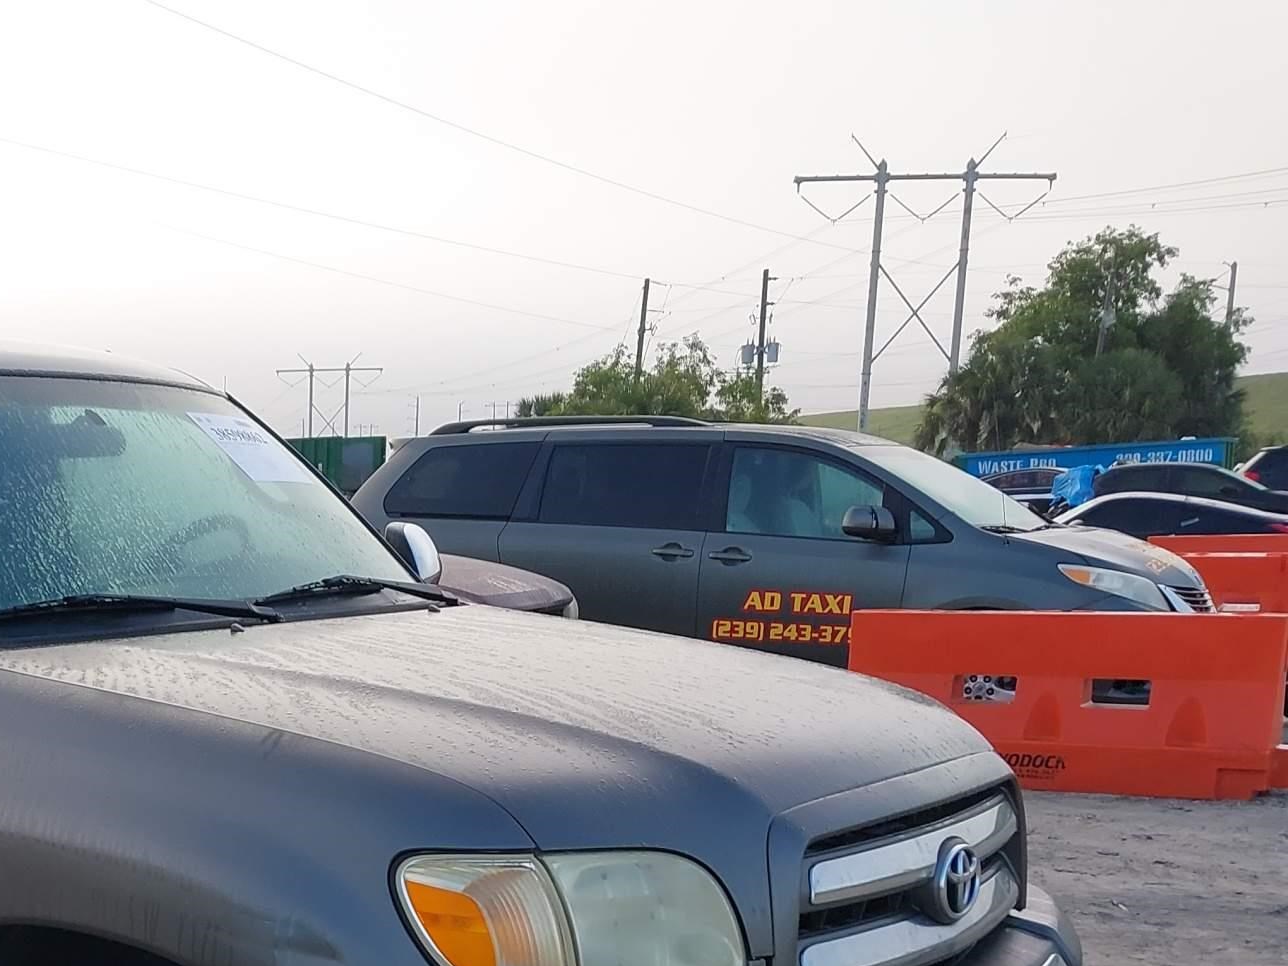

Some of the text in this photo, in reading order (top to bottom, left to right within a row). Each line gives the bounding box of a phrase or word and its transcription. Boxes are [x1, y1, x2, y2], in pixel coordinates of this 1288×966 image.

[978, 460, 1023, 474] WASTE
[743, 591, 852, 614] AD TAXI
[712, 619, 852, 643] (239) 243-37
